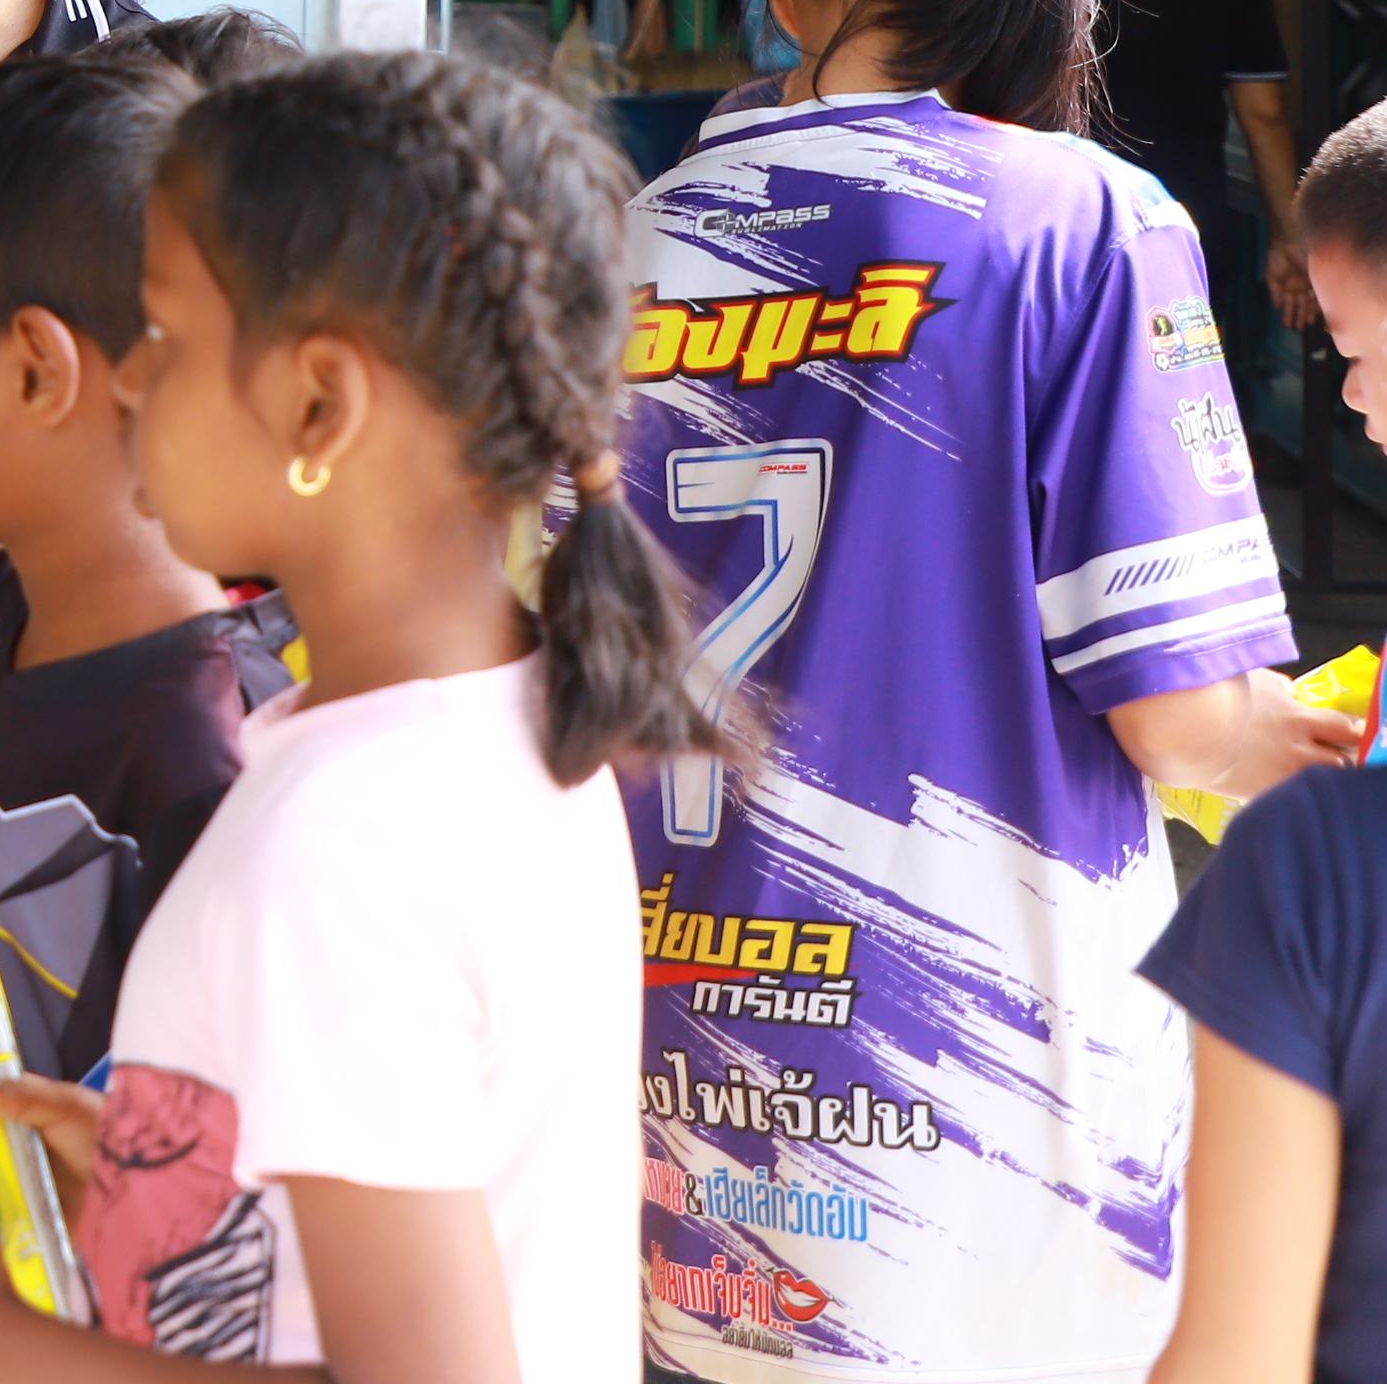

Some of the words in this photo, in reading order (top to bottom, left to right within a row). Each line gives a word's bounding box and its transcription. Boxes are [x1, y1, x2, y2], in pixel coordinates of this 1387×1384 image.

[665, 438, 834, 848] 7
[641, 870, 854, 975] สี่ยบอล
[692, 974, 855, 1026] การันตี
